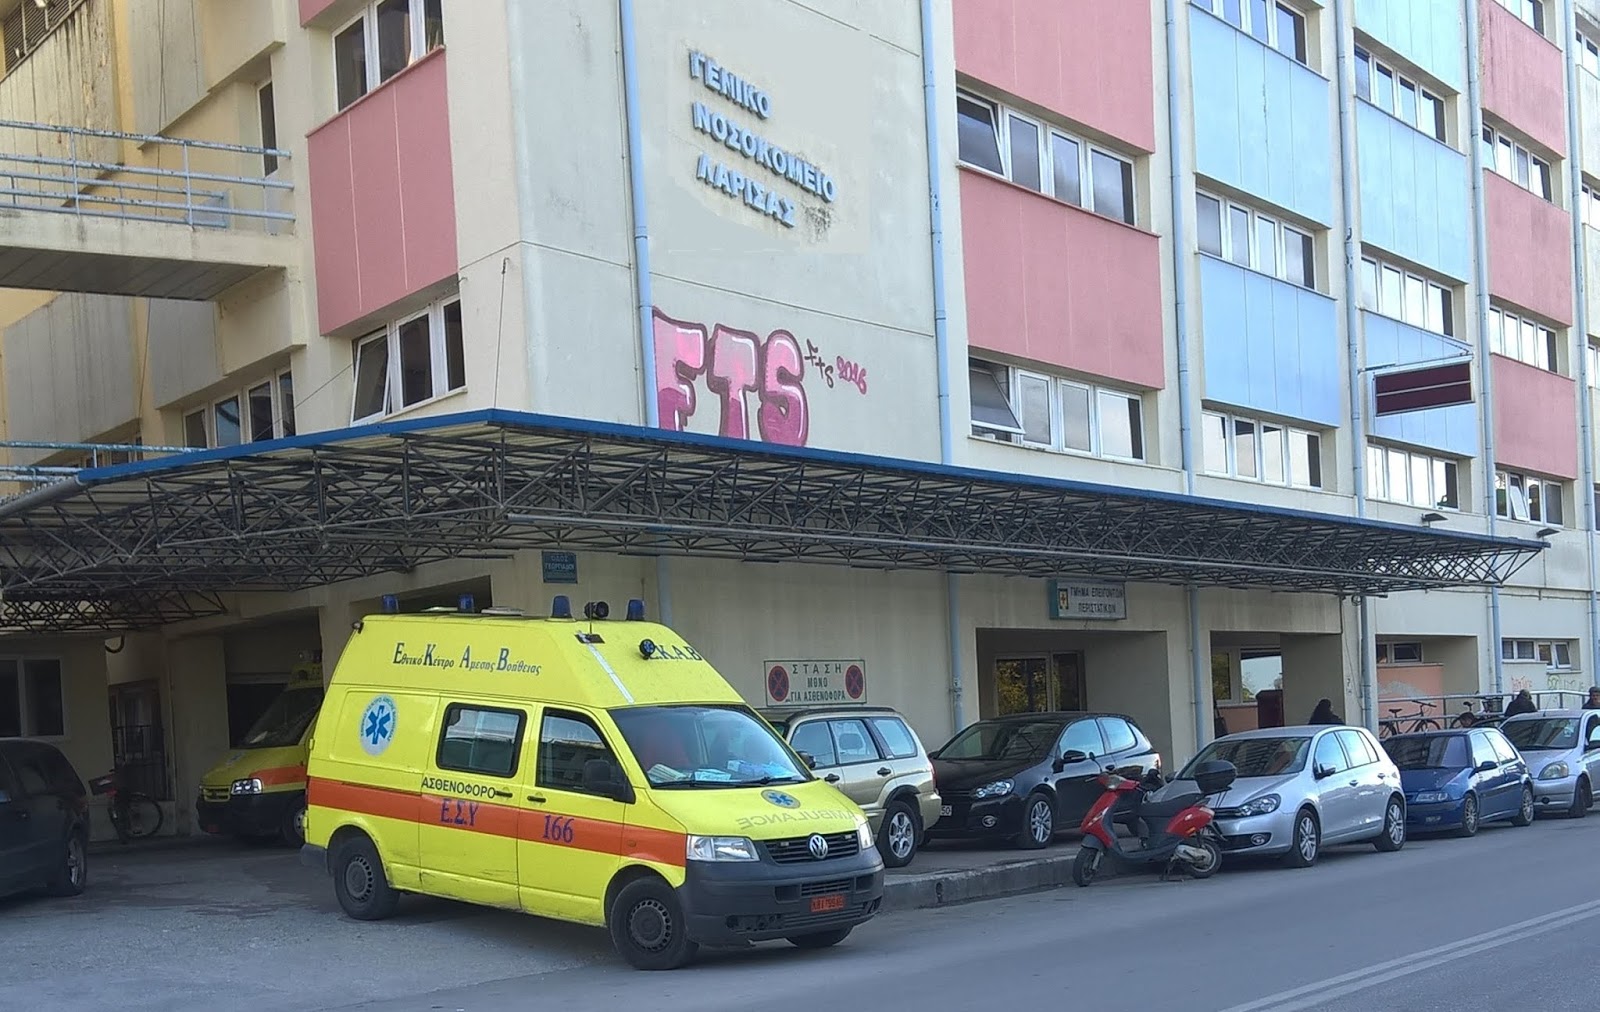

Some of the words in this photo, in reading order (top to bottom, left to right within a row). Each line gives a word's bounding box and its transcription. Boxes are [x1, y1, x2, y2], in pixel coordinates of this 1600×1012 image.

[689, 51, 772, 120] ΓΕΝΙΚΟ
[692, 101, 838, 203] ΝΟΣΟΚΟΜΕΙΟ
[697, 152, 795, 228] ΛΑΡΙΣΑΣ
[652, 306, 809, 447] FTS
[1070, 586, 1089, 597] ΤΜΗΜΑ
[791, 691, 801, 701] ΓΙΑ
[804, 690, 846, 701] ΑΣΘΕΝΟΦΟΡΑ
[421, 776, 496, 799] ΑΣΘΕΝΟΦΟΡΟ
[542, 814, 575, 843] 166
